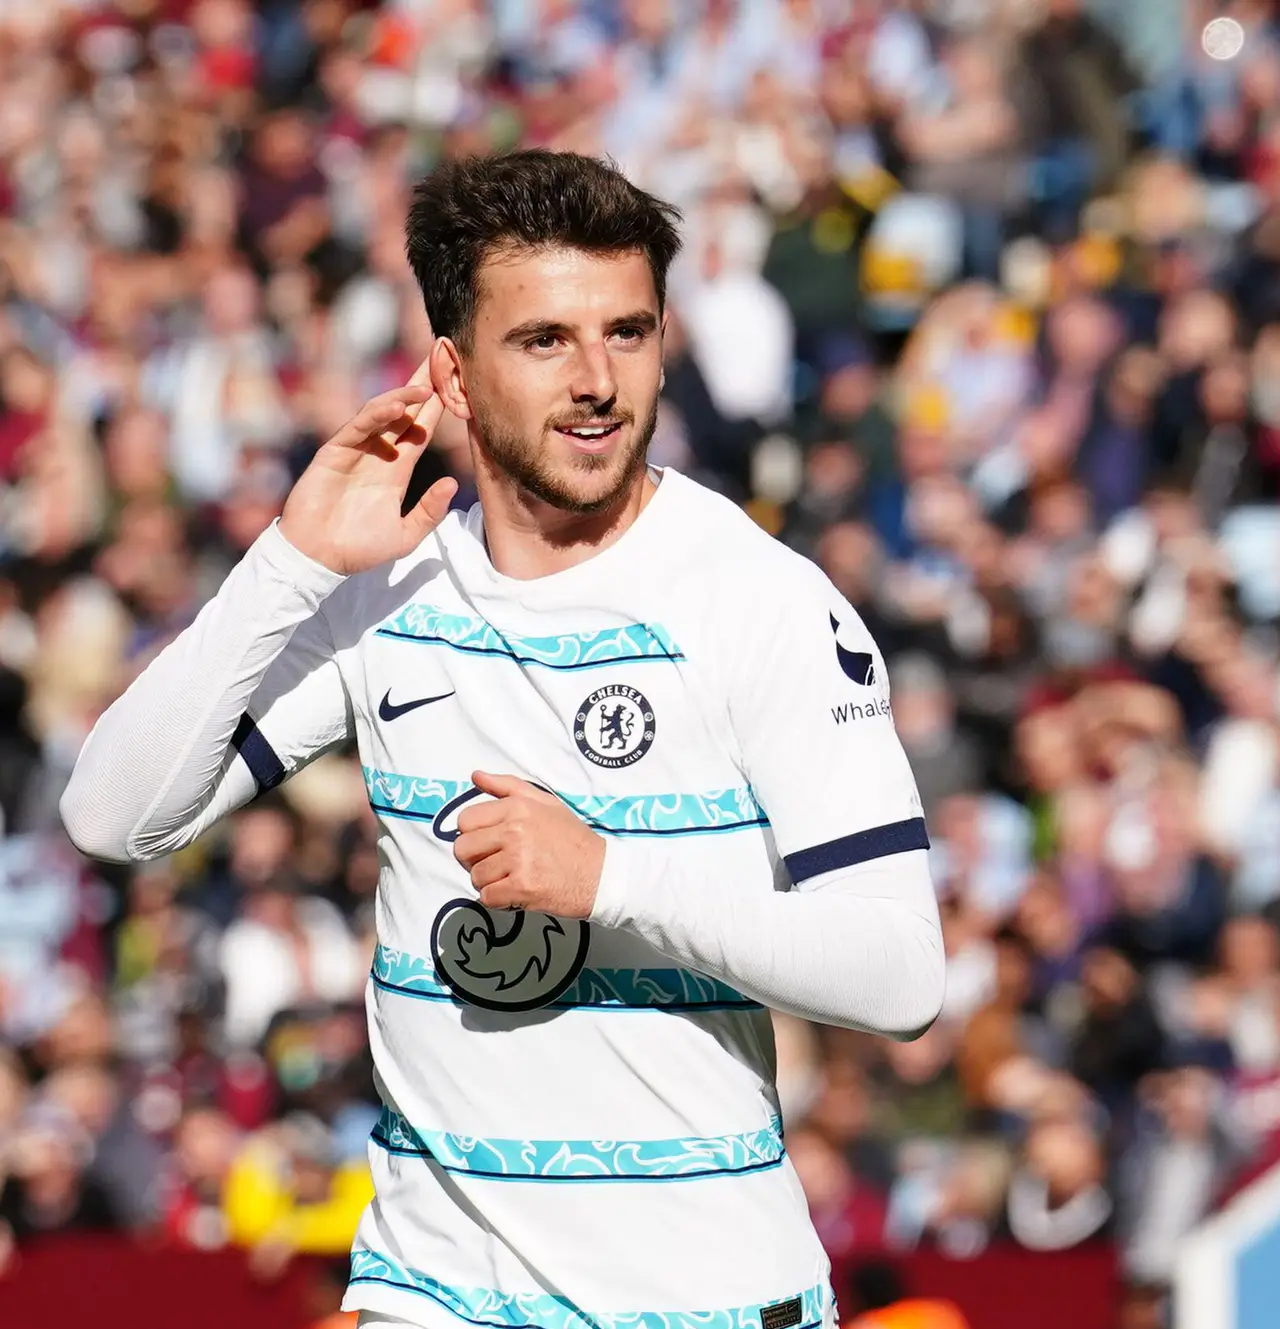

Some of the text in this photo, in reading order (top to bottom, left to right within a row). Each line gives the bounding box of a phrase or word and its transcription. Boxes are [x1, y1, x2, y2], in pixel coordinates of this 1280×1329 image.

[588, 685, 643, 704] CHELSEA
[584, 749, 643, 767] FOOTBALL CLUB
